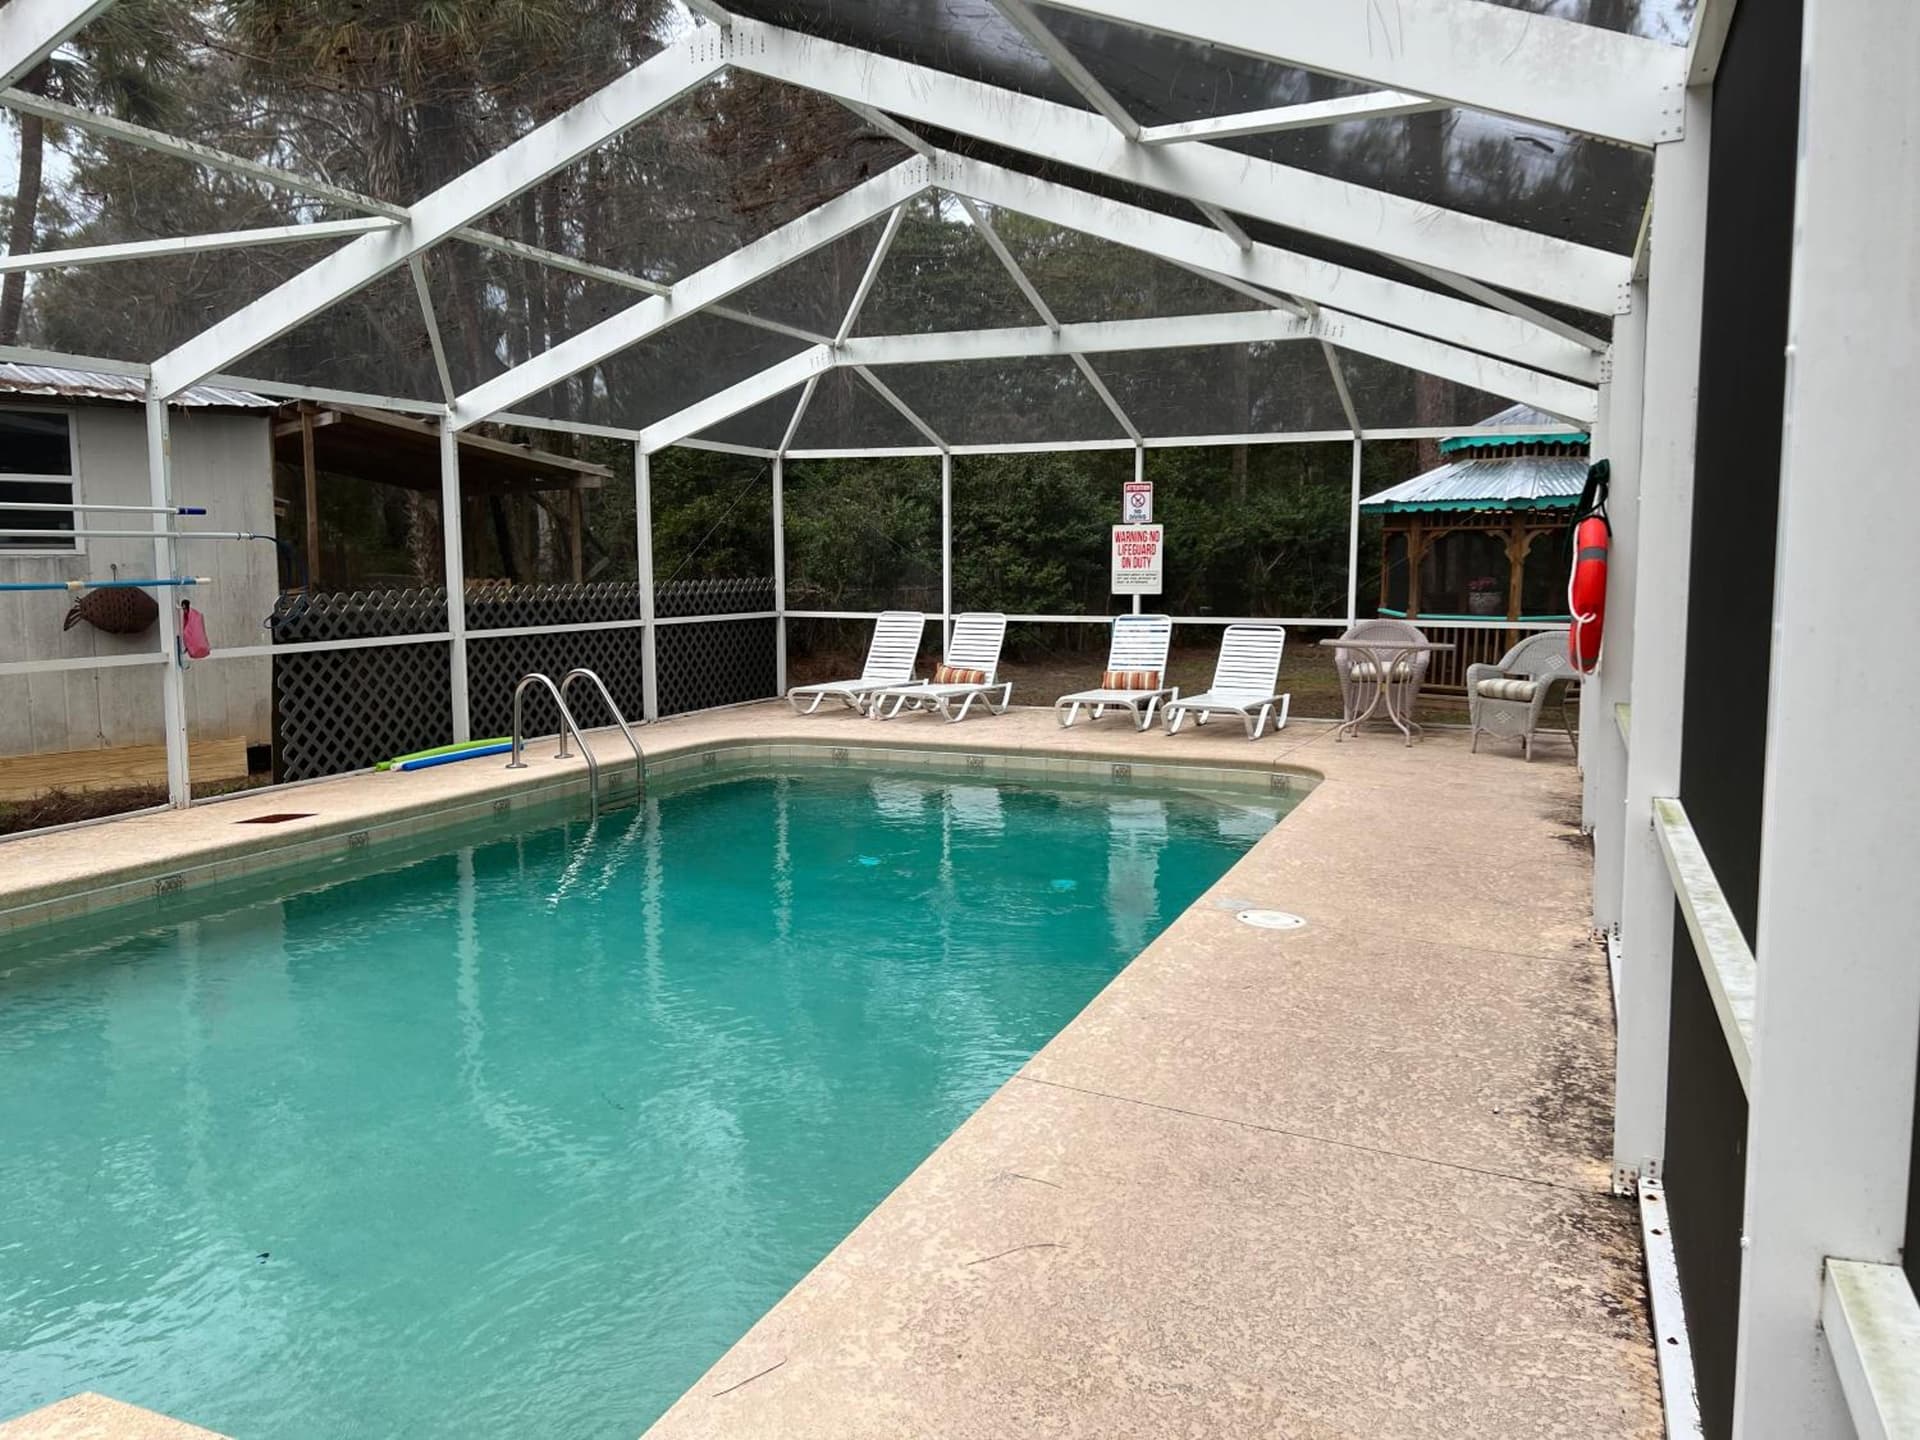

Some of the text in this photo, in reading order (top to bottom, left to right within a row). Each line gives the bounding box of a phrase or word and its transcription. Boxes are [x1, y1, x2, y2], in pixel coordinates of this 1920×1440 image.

[1115, 530, 1160, 543] WARNING NO
[1118, 544, 1156, 556] LIFEGUARD
[1122, 557, 1152, 568] ON DUTY
